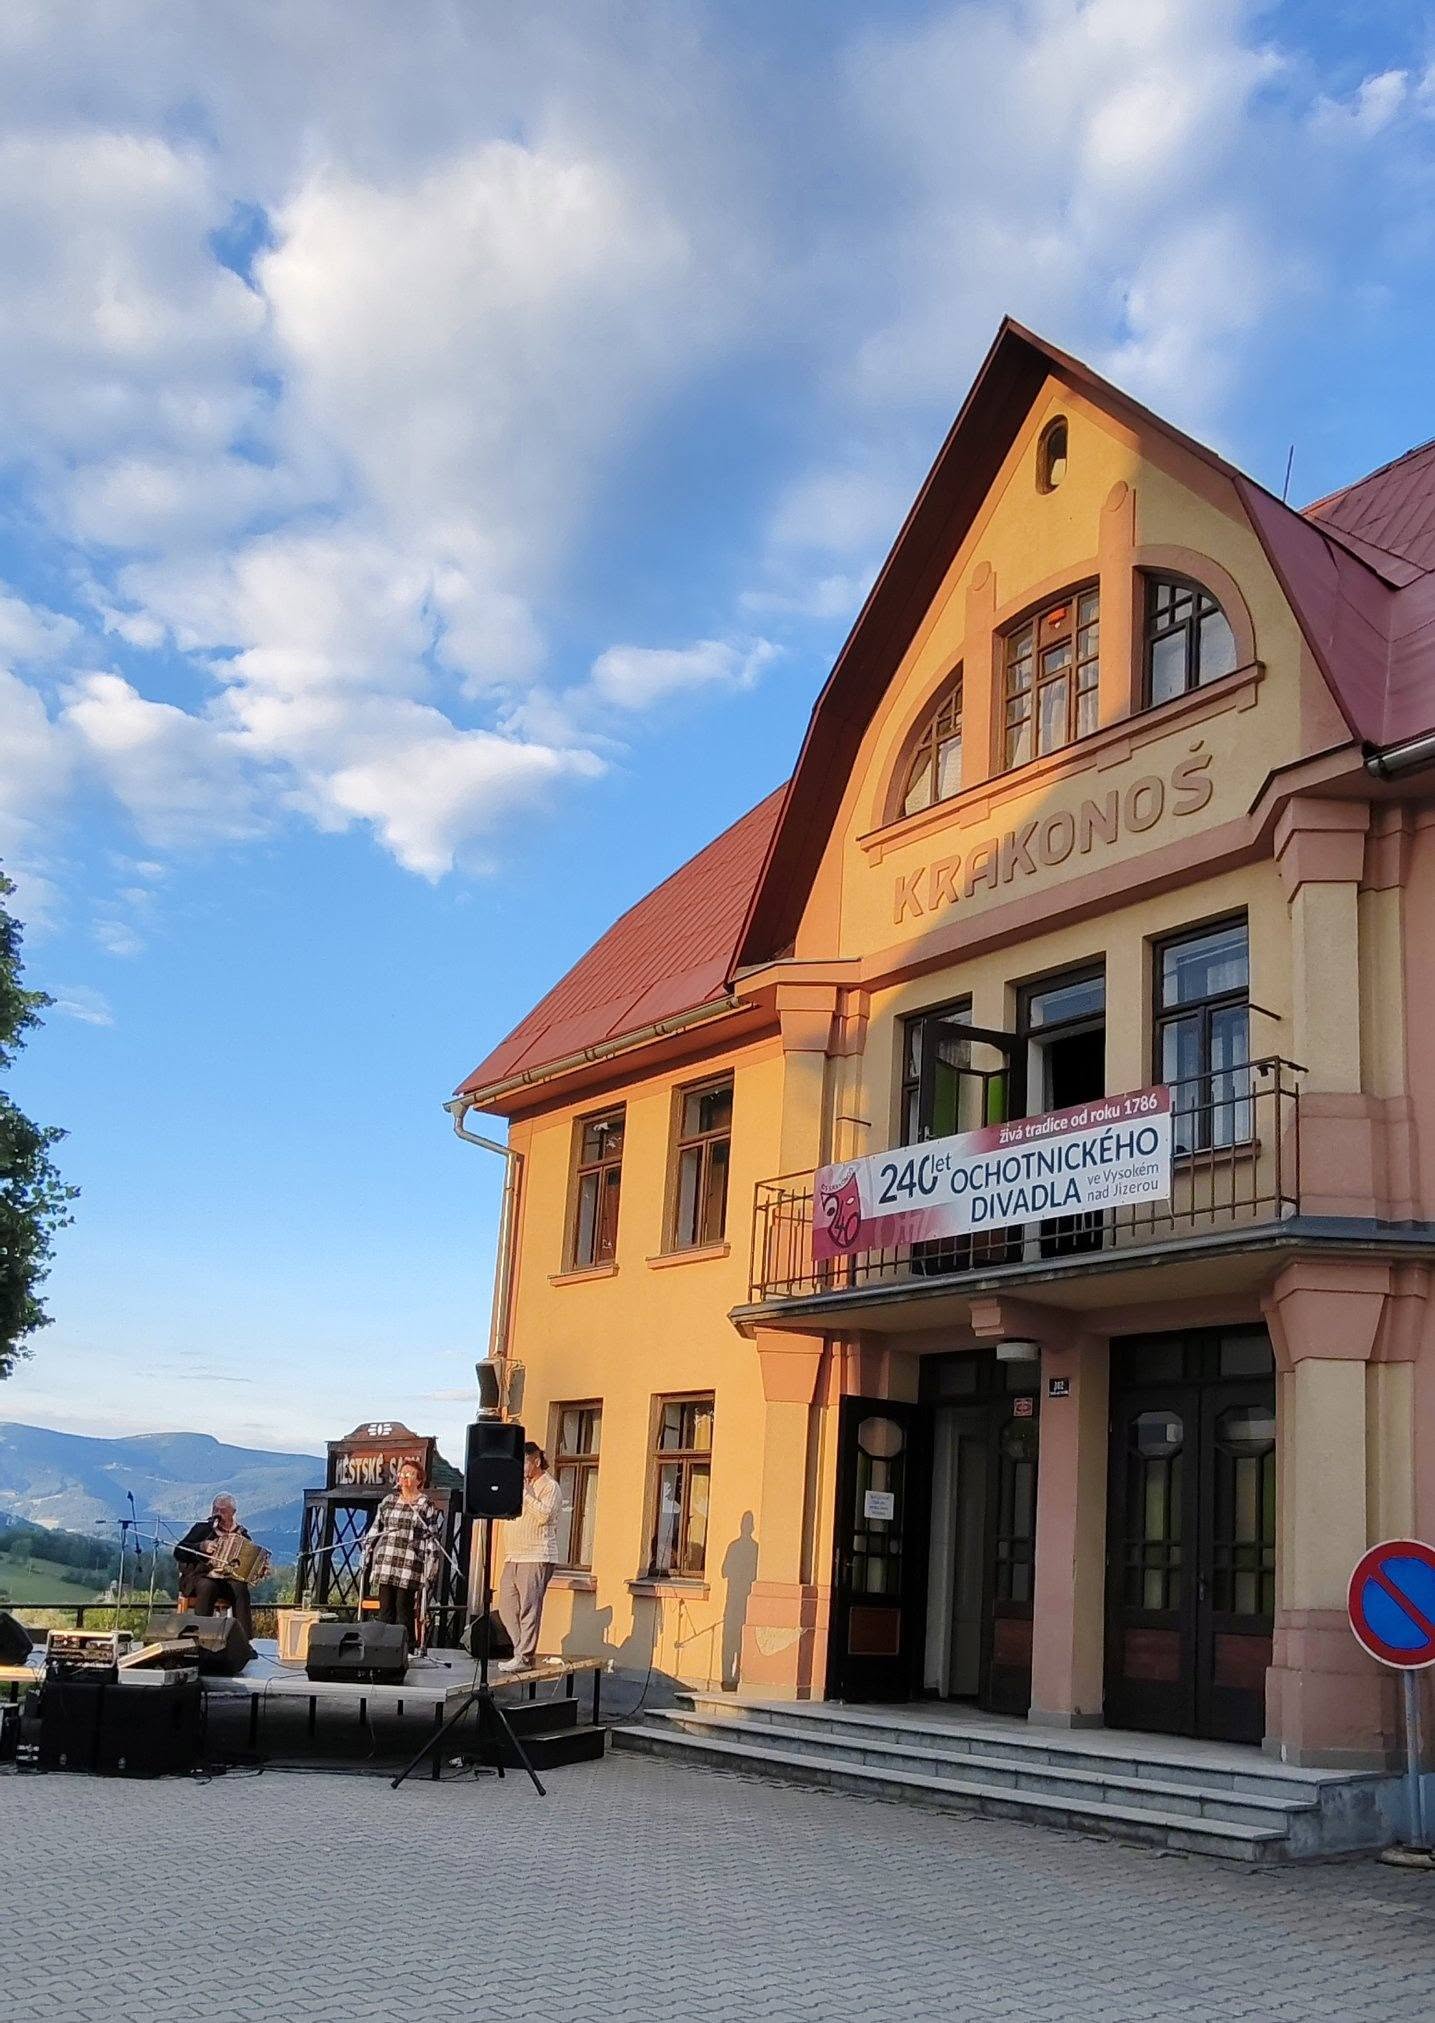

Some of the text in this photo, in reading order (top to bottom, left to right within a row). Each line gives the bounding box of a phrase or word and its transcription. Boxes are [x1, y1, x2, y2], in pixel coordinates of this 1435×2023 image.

[892, 740, 1213, 924] KRAKONOŠ
[999, 1093, 1158, 1144] živá tradice od roku 1786
[879, 1127, 1159, 1204] 240 let OCHOTNICKÉHO
[1086, 1161, 1160, 1186] ve Vysokém
[971, 1178, 1082, 1223] DIVADLA
[1087, 1179, 1159, 1202] nad Jizerou
[335, 1452, 384, 1485] MĚSTSKÉ
